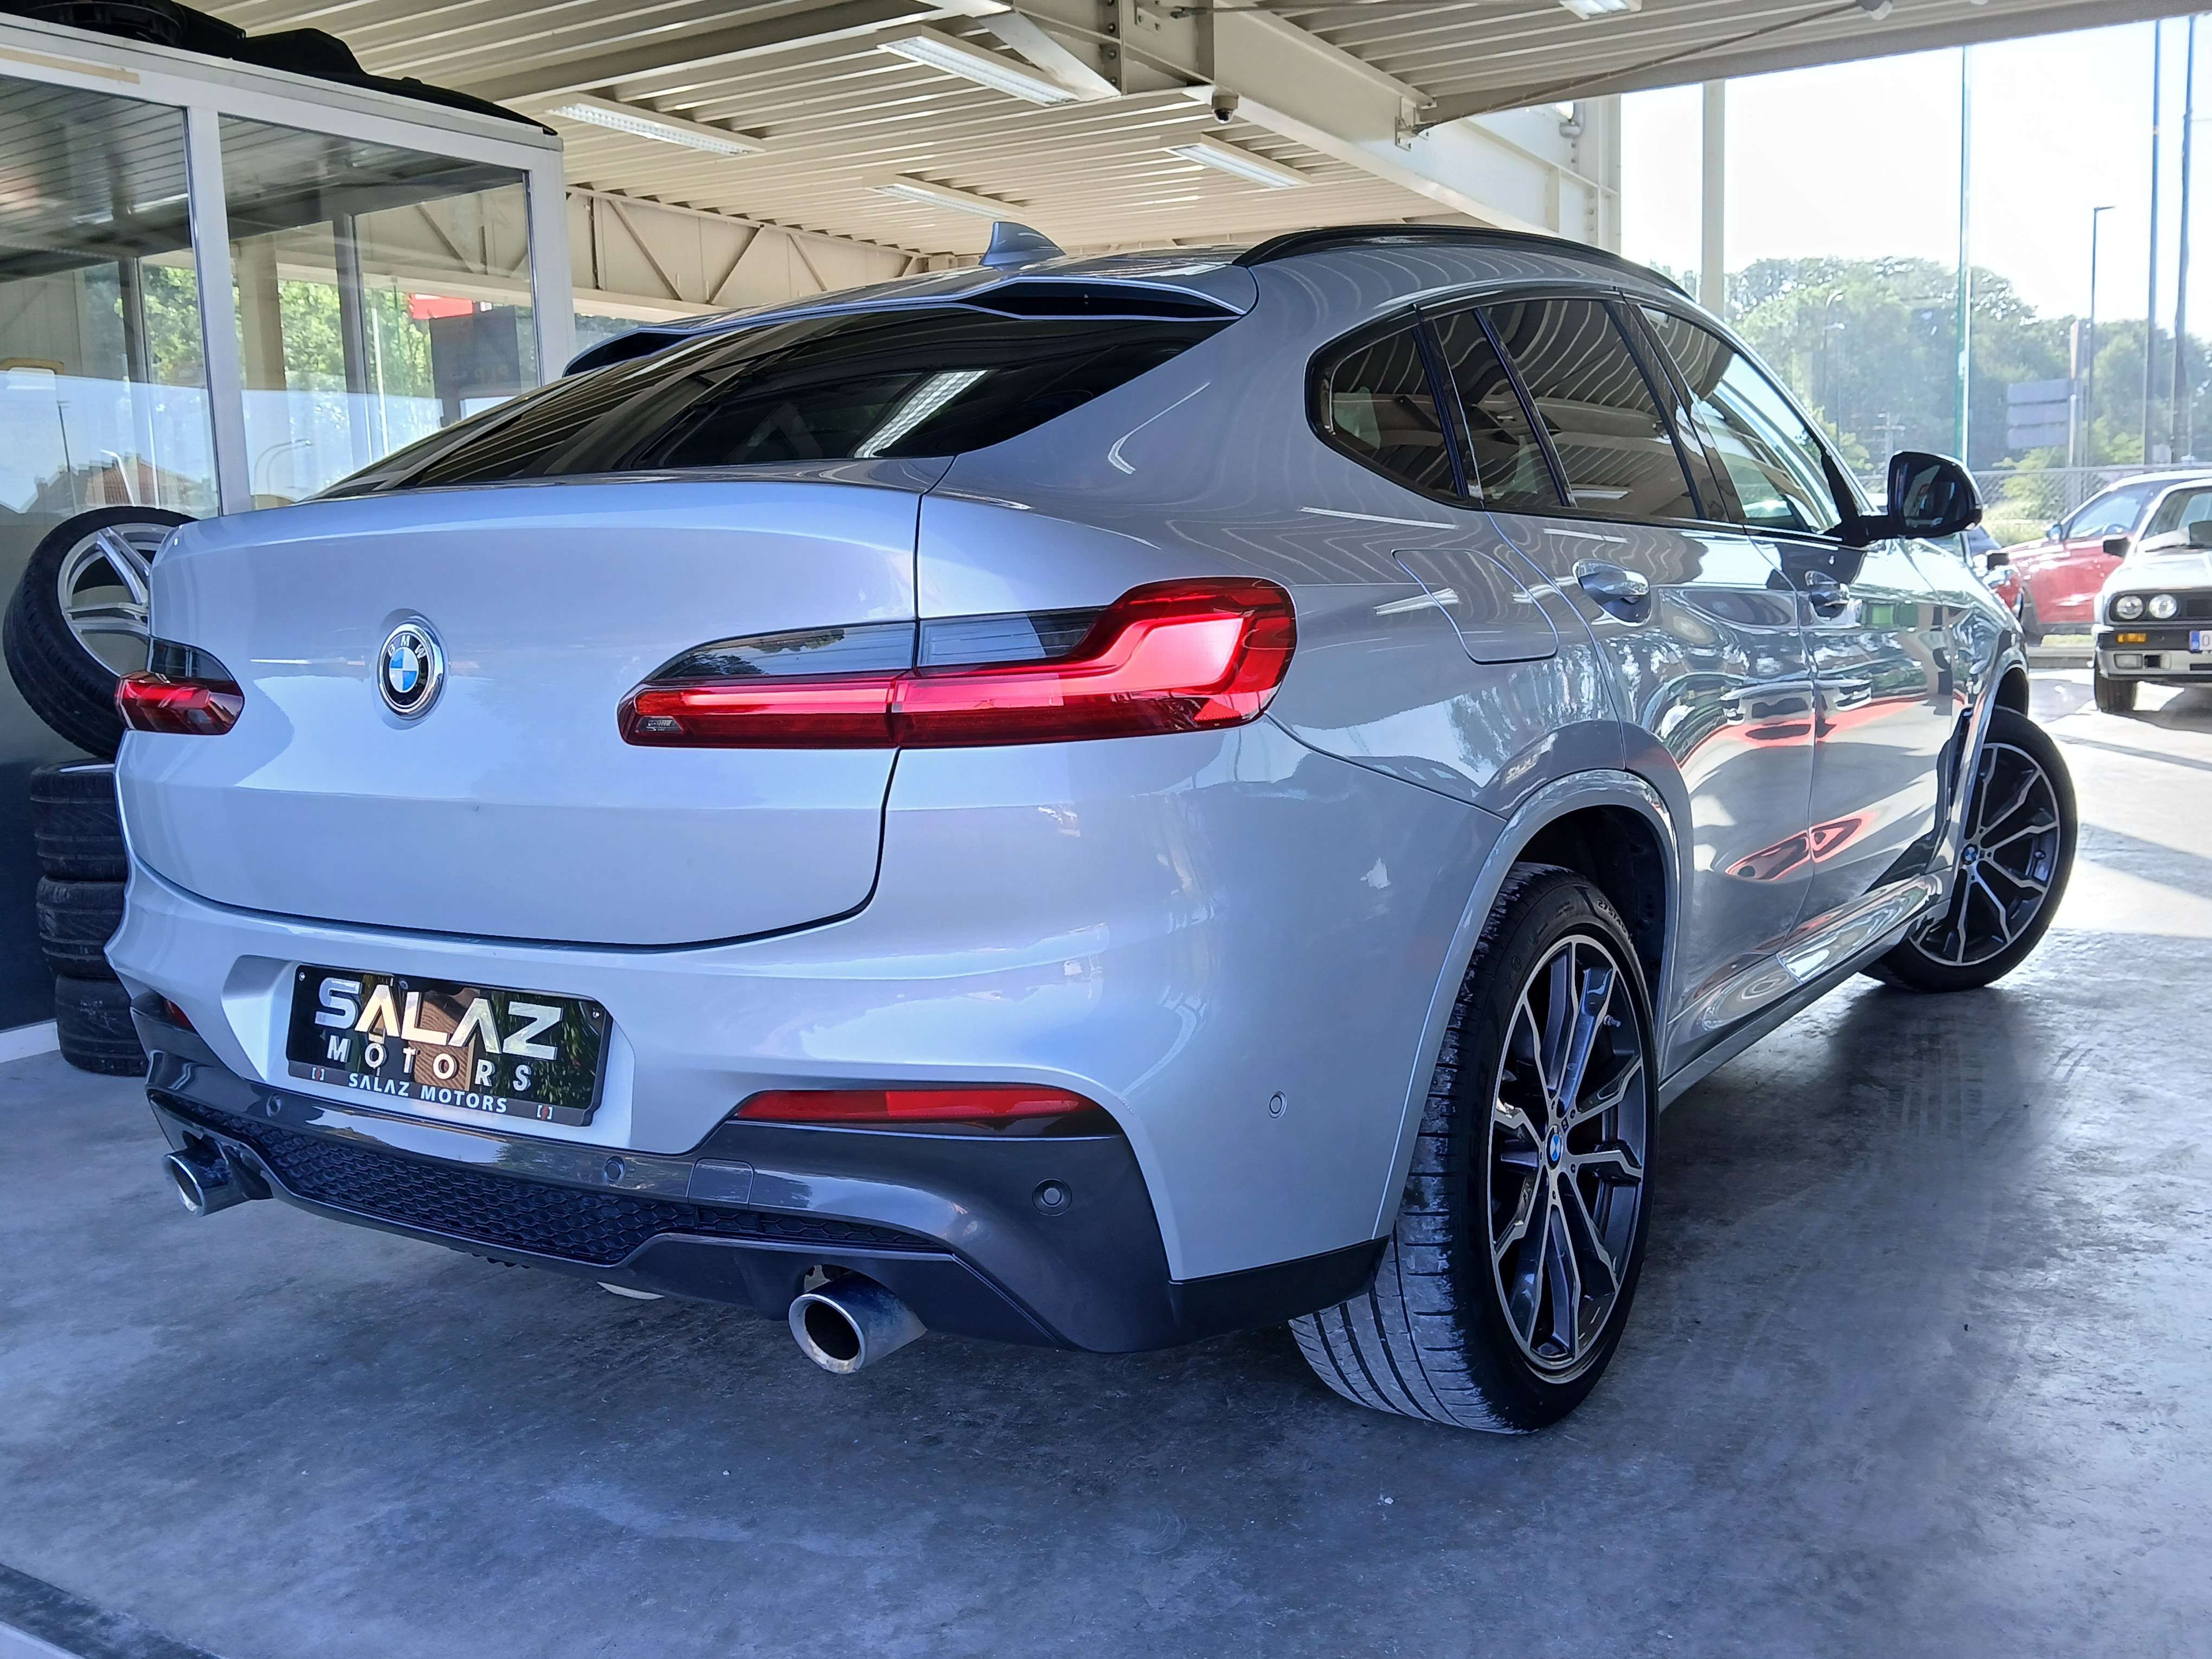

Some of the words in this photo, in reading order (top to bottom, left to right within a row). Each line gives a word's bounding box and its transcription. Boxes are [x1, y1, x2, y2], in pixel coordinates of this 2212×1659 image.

[387, 635, 426, 659] BMW
[314, 977, 563, 1060] SALAZ
[327, 1034, 531, 1091] MOTORS
[349, 1073, 409, 1097] SALAZ
[421, 1086, 507, 1113] MOTORS
